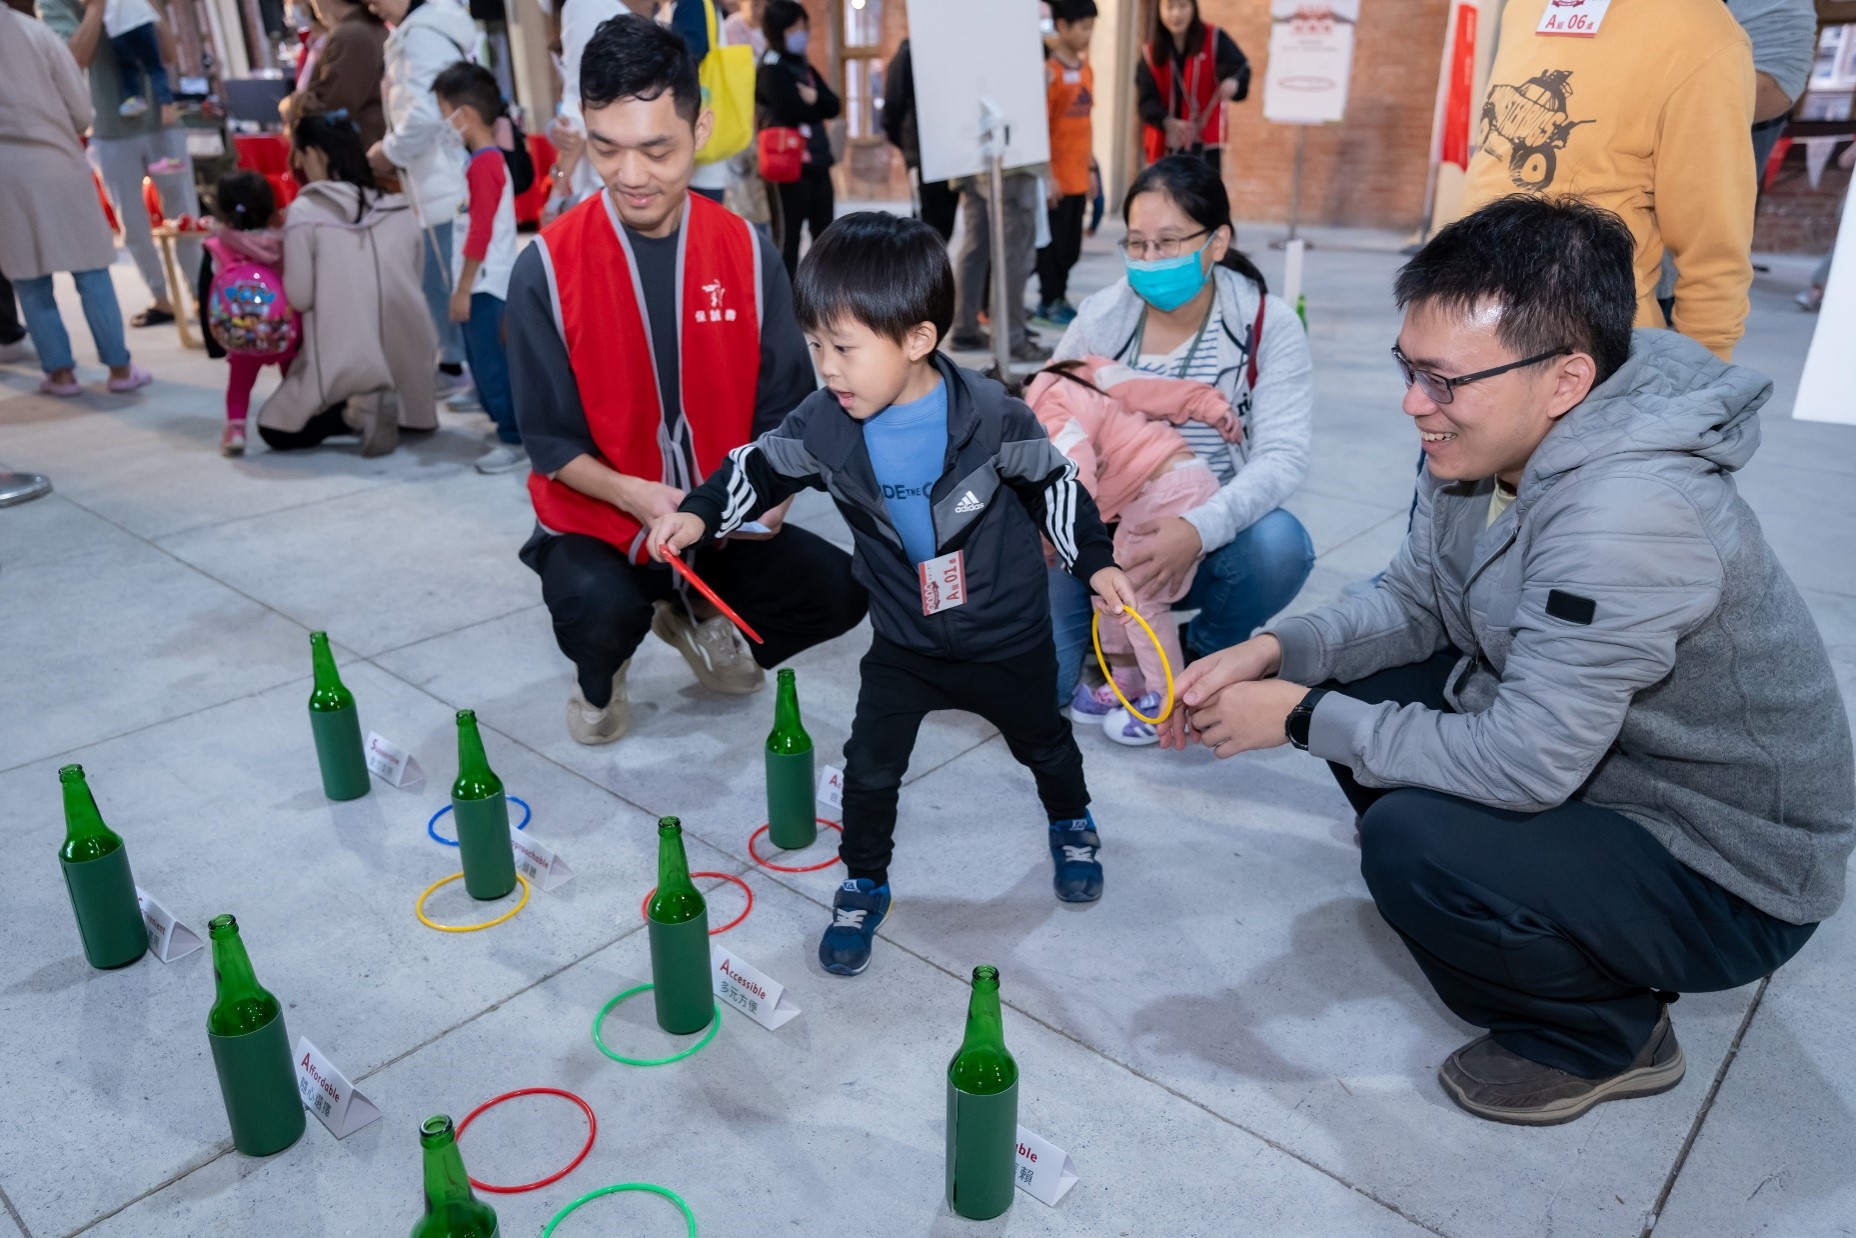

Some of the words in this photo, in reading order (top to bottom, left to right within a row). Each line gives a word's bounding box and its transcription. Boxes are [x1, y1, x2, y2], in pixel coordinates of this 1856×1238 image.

[954, 502, 984, 514] adidas
[720, 958, 766, 1000] Accessible
[720, 980, 758, 1015] 多元方便
[301, 1052, 340, 1103] Affordable
